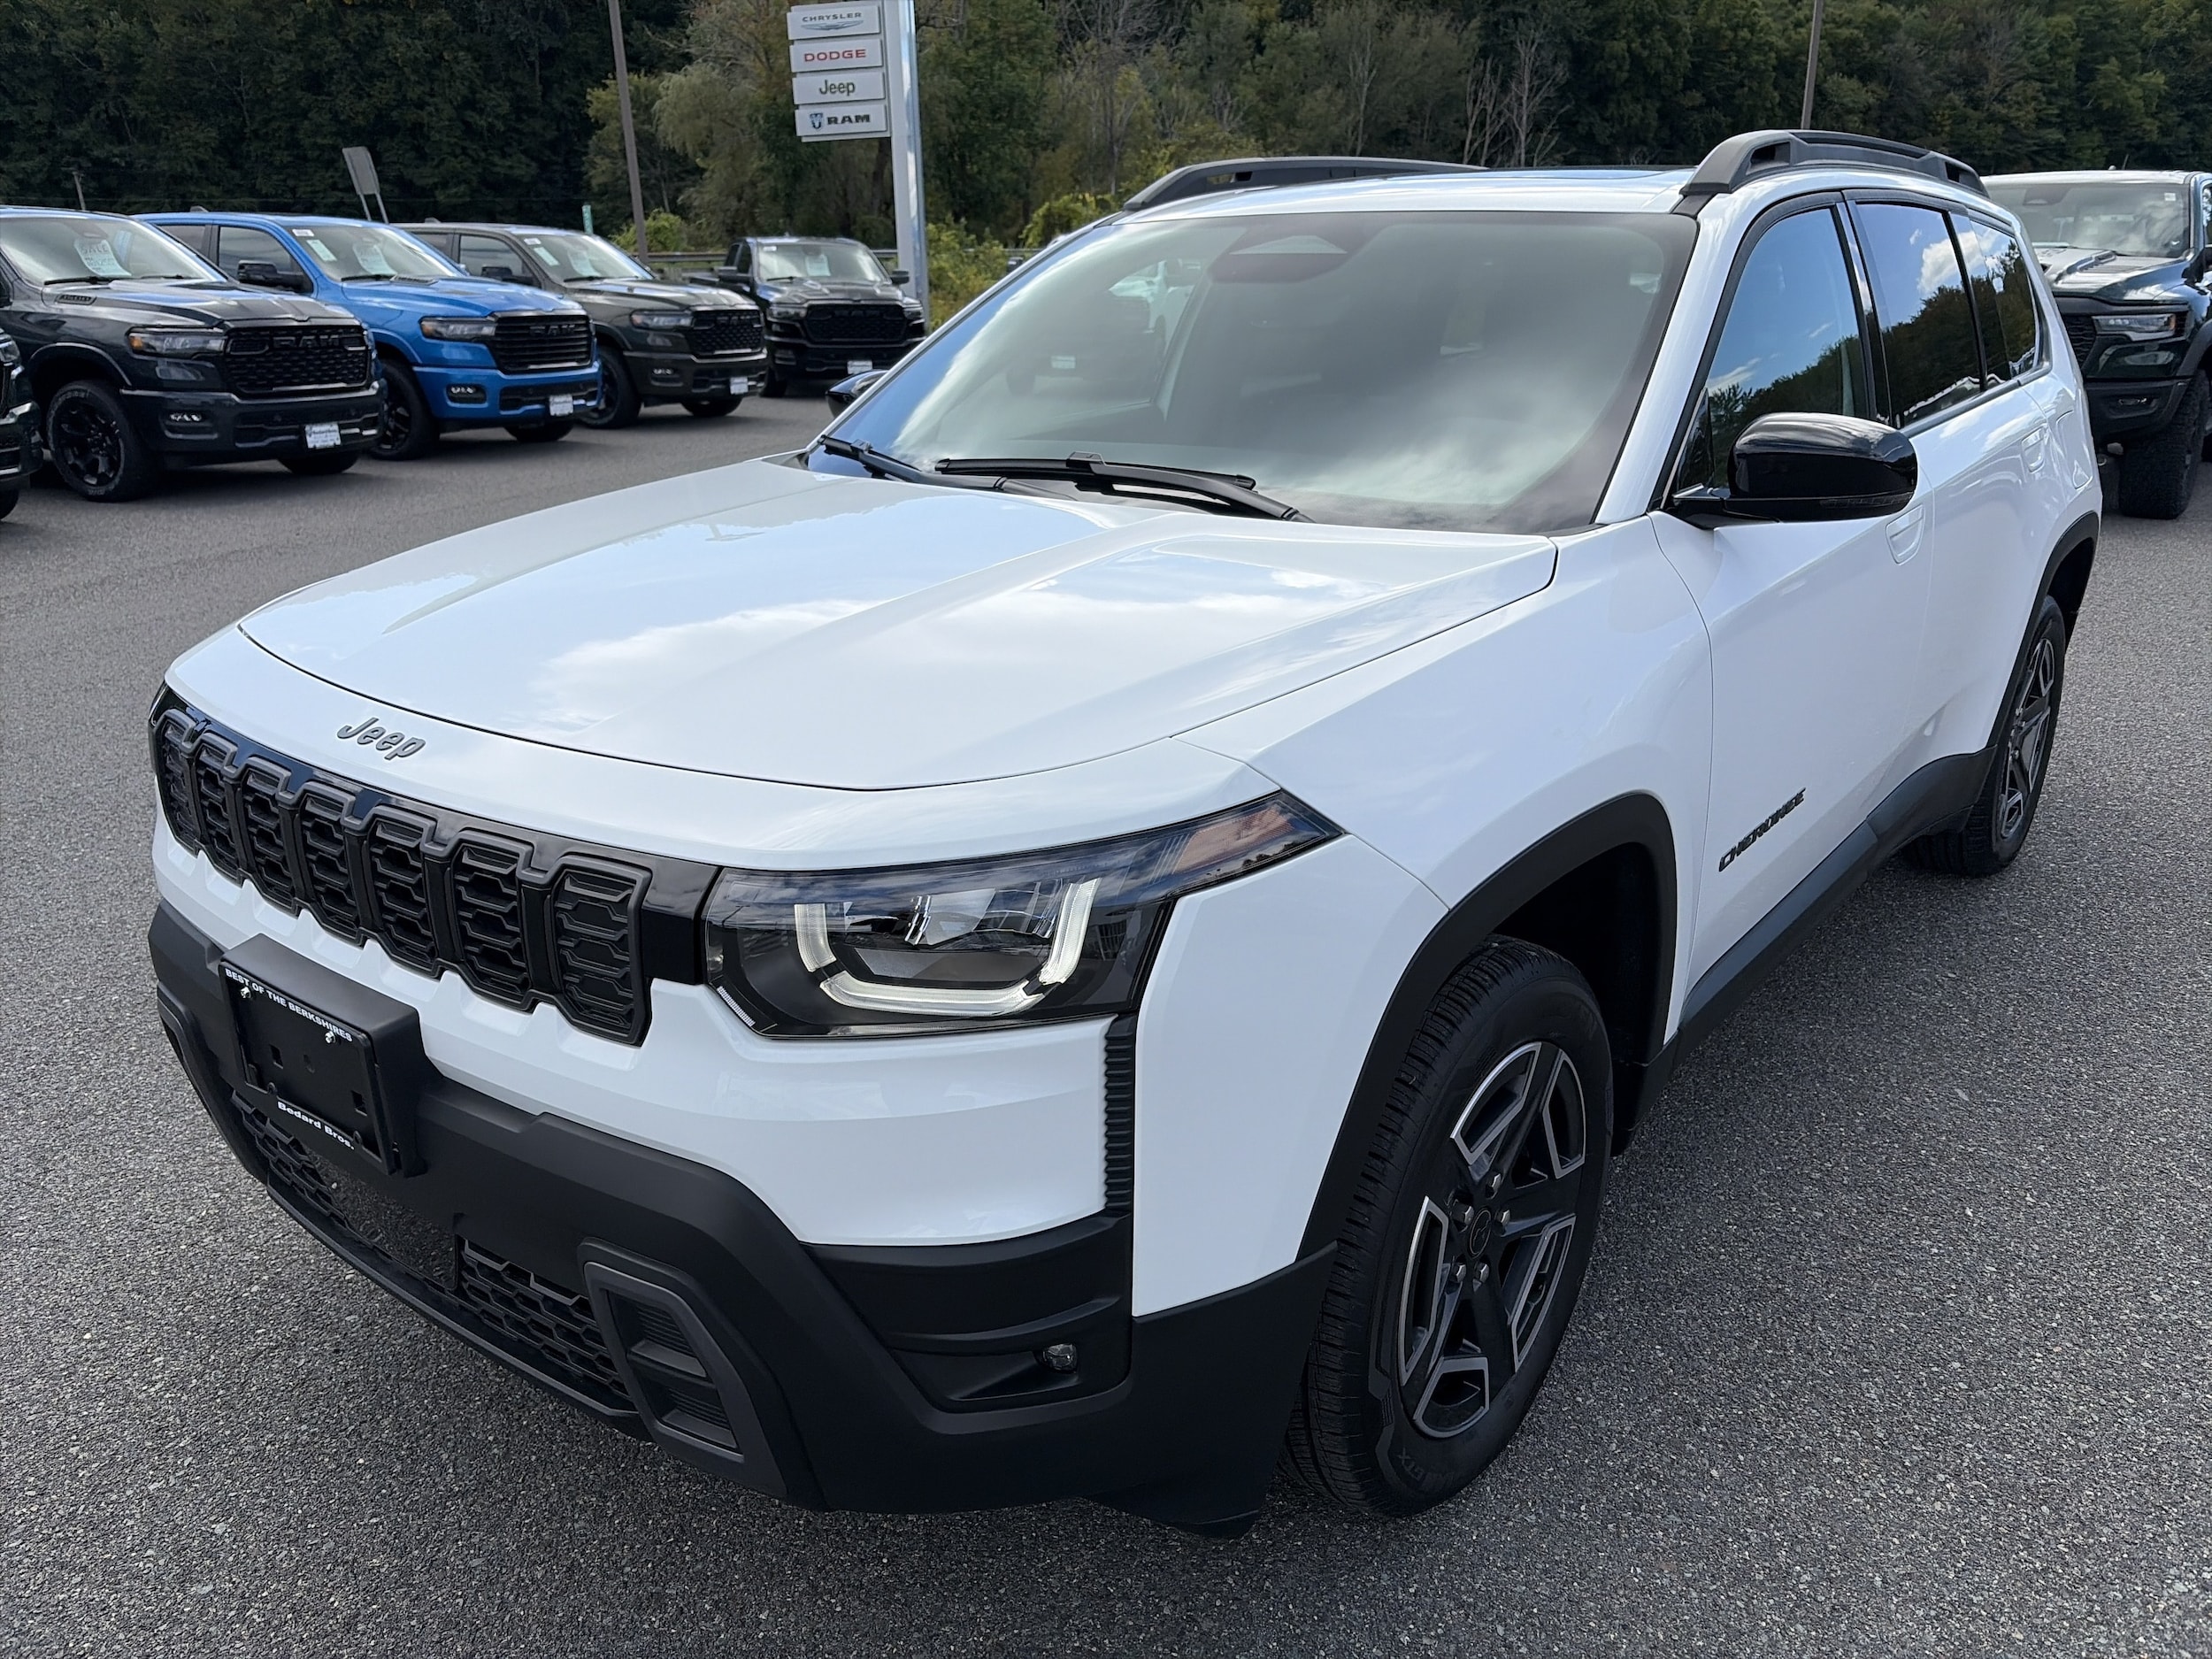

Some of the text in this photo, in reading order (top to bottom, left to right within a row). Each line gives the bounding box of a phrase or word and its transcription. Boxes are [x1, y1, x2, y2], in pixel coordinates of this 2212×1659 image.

[802, 12, 862, 22] CHRYSLER
[803, 49, 867, 62] DODGE
[818, 79, 856, 96] Jeep
[826, 114, 871, 125] RAM
[336, 717, 426, 761] Jeep
[1719, 787, 1806, 872] CHEROKEE
[225, 967, 353, 1043] BEST OF THE BERKSHIRES
[277, 1101, 355, 1150] Bedard Bros.
